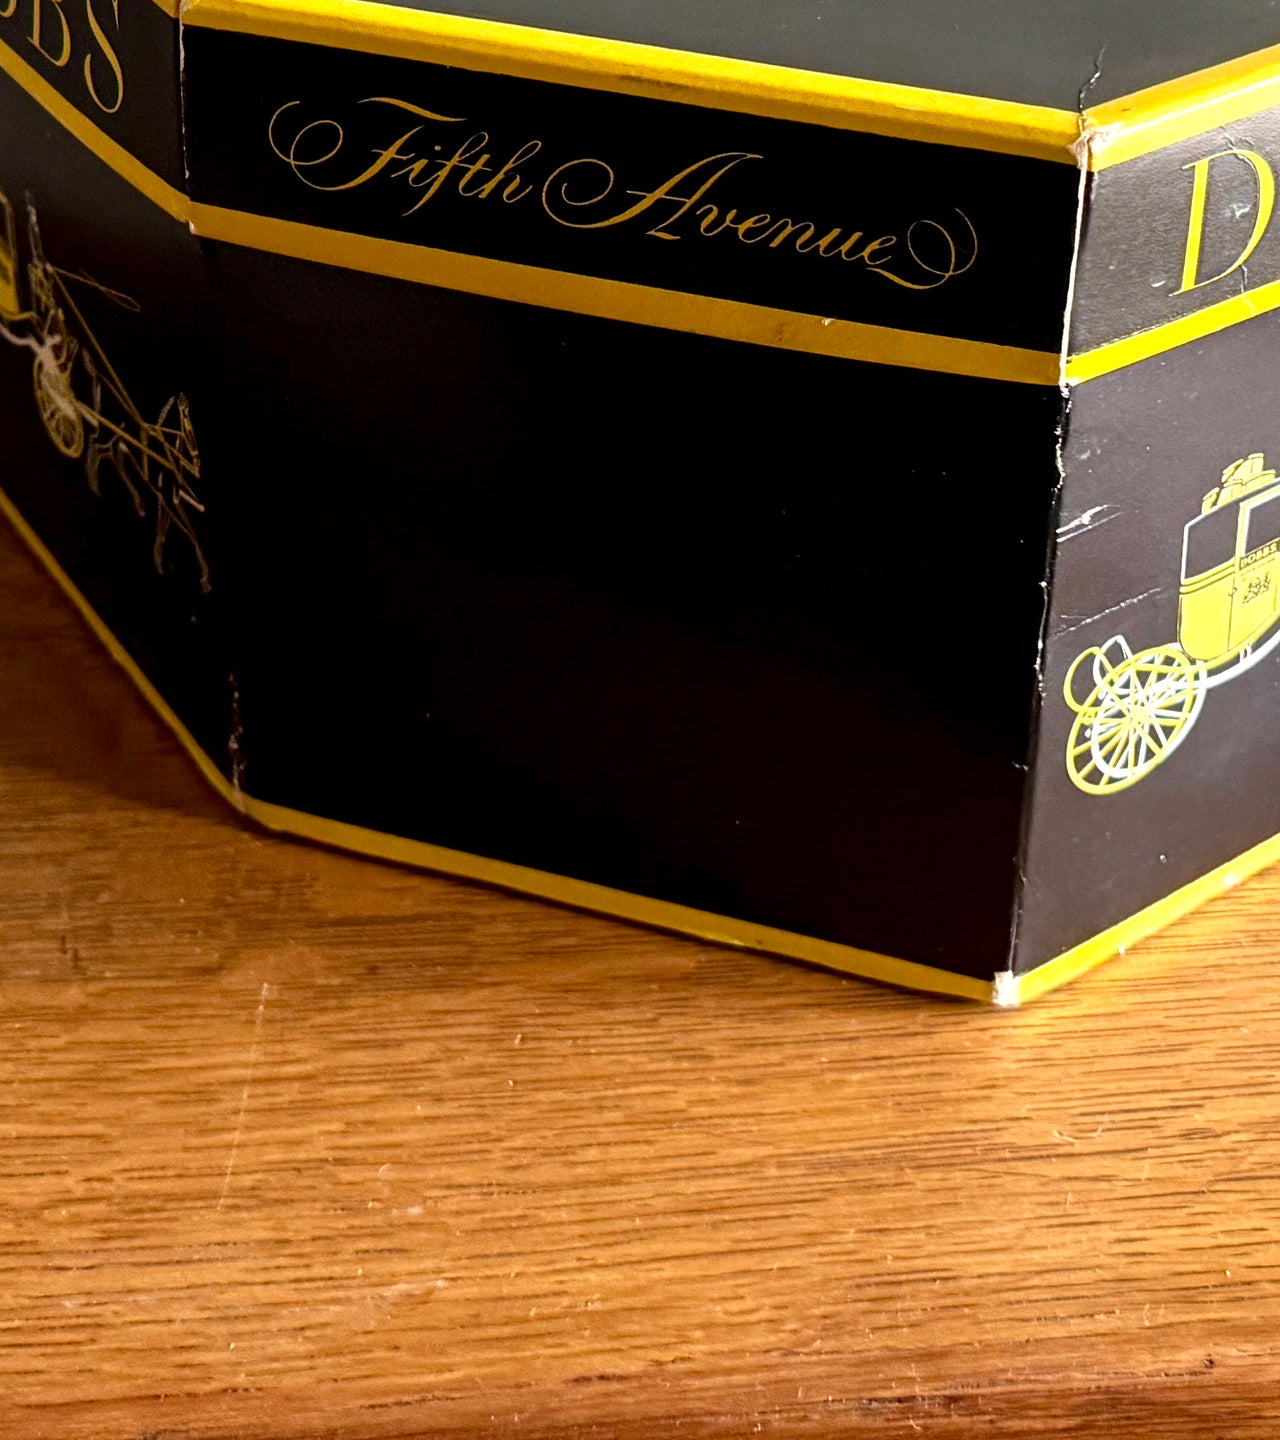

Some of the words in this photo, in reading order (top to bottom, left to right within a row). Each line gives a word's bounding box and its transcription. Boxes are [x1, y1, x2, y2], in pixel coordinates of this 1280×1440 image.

[269, 96, 542, 218] Fifth
[542, 151, 979, 290] Avenue
[1240, 542, 1279, 569] DOBBS
